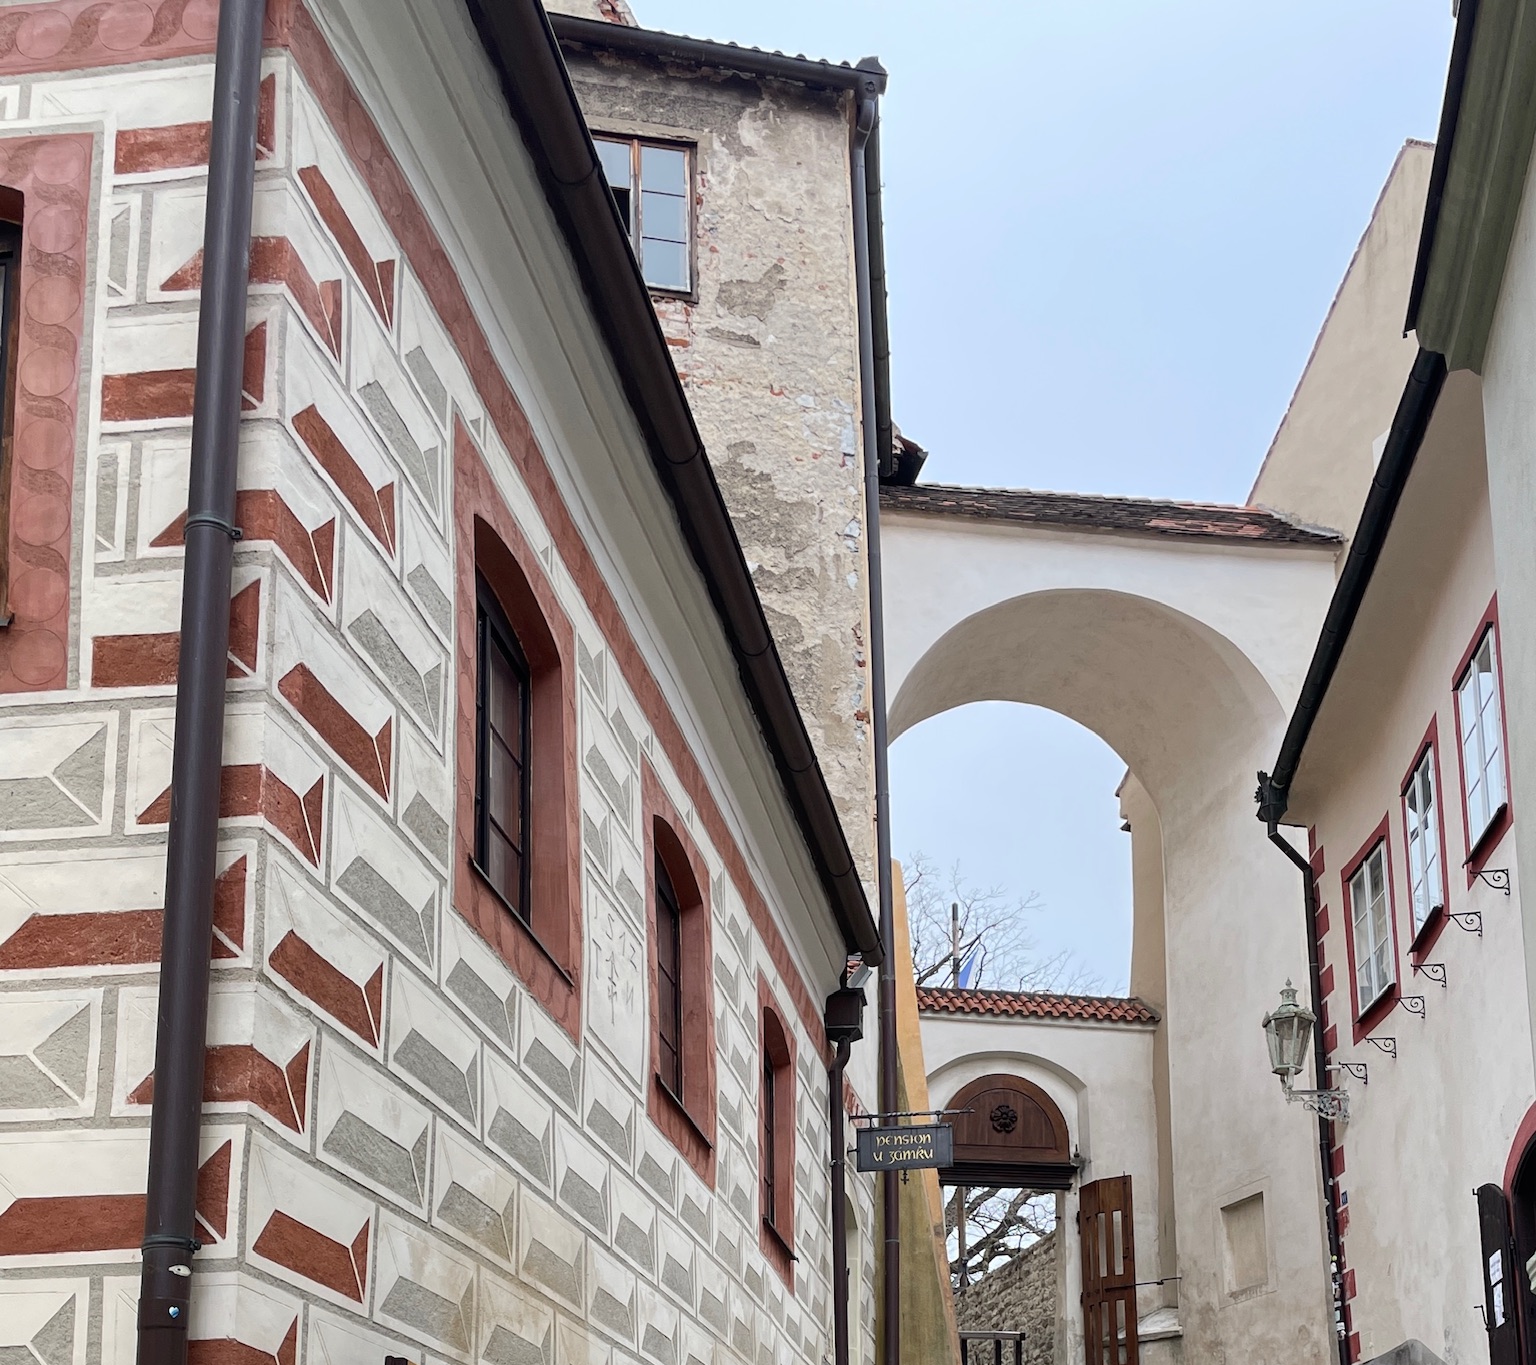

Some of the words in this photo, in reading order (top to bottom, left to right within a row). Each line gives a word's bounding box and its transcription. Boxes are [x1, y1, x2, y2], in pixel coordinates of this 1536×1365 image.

[876, 1133, 931, 1148] pension
[873, 1151, 883, 1162] u
[888, 1146, 933, 1164] zámku
